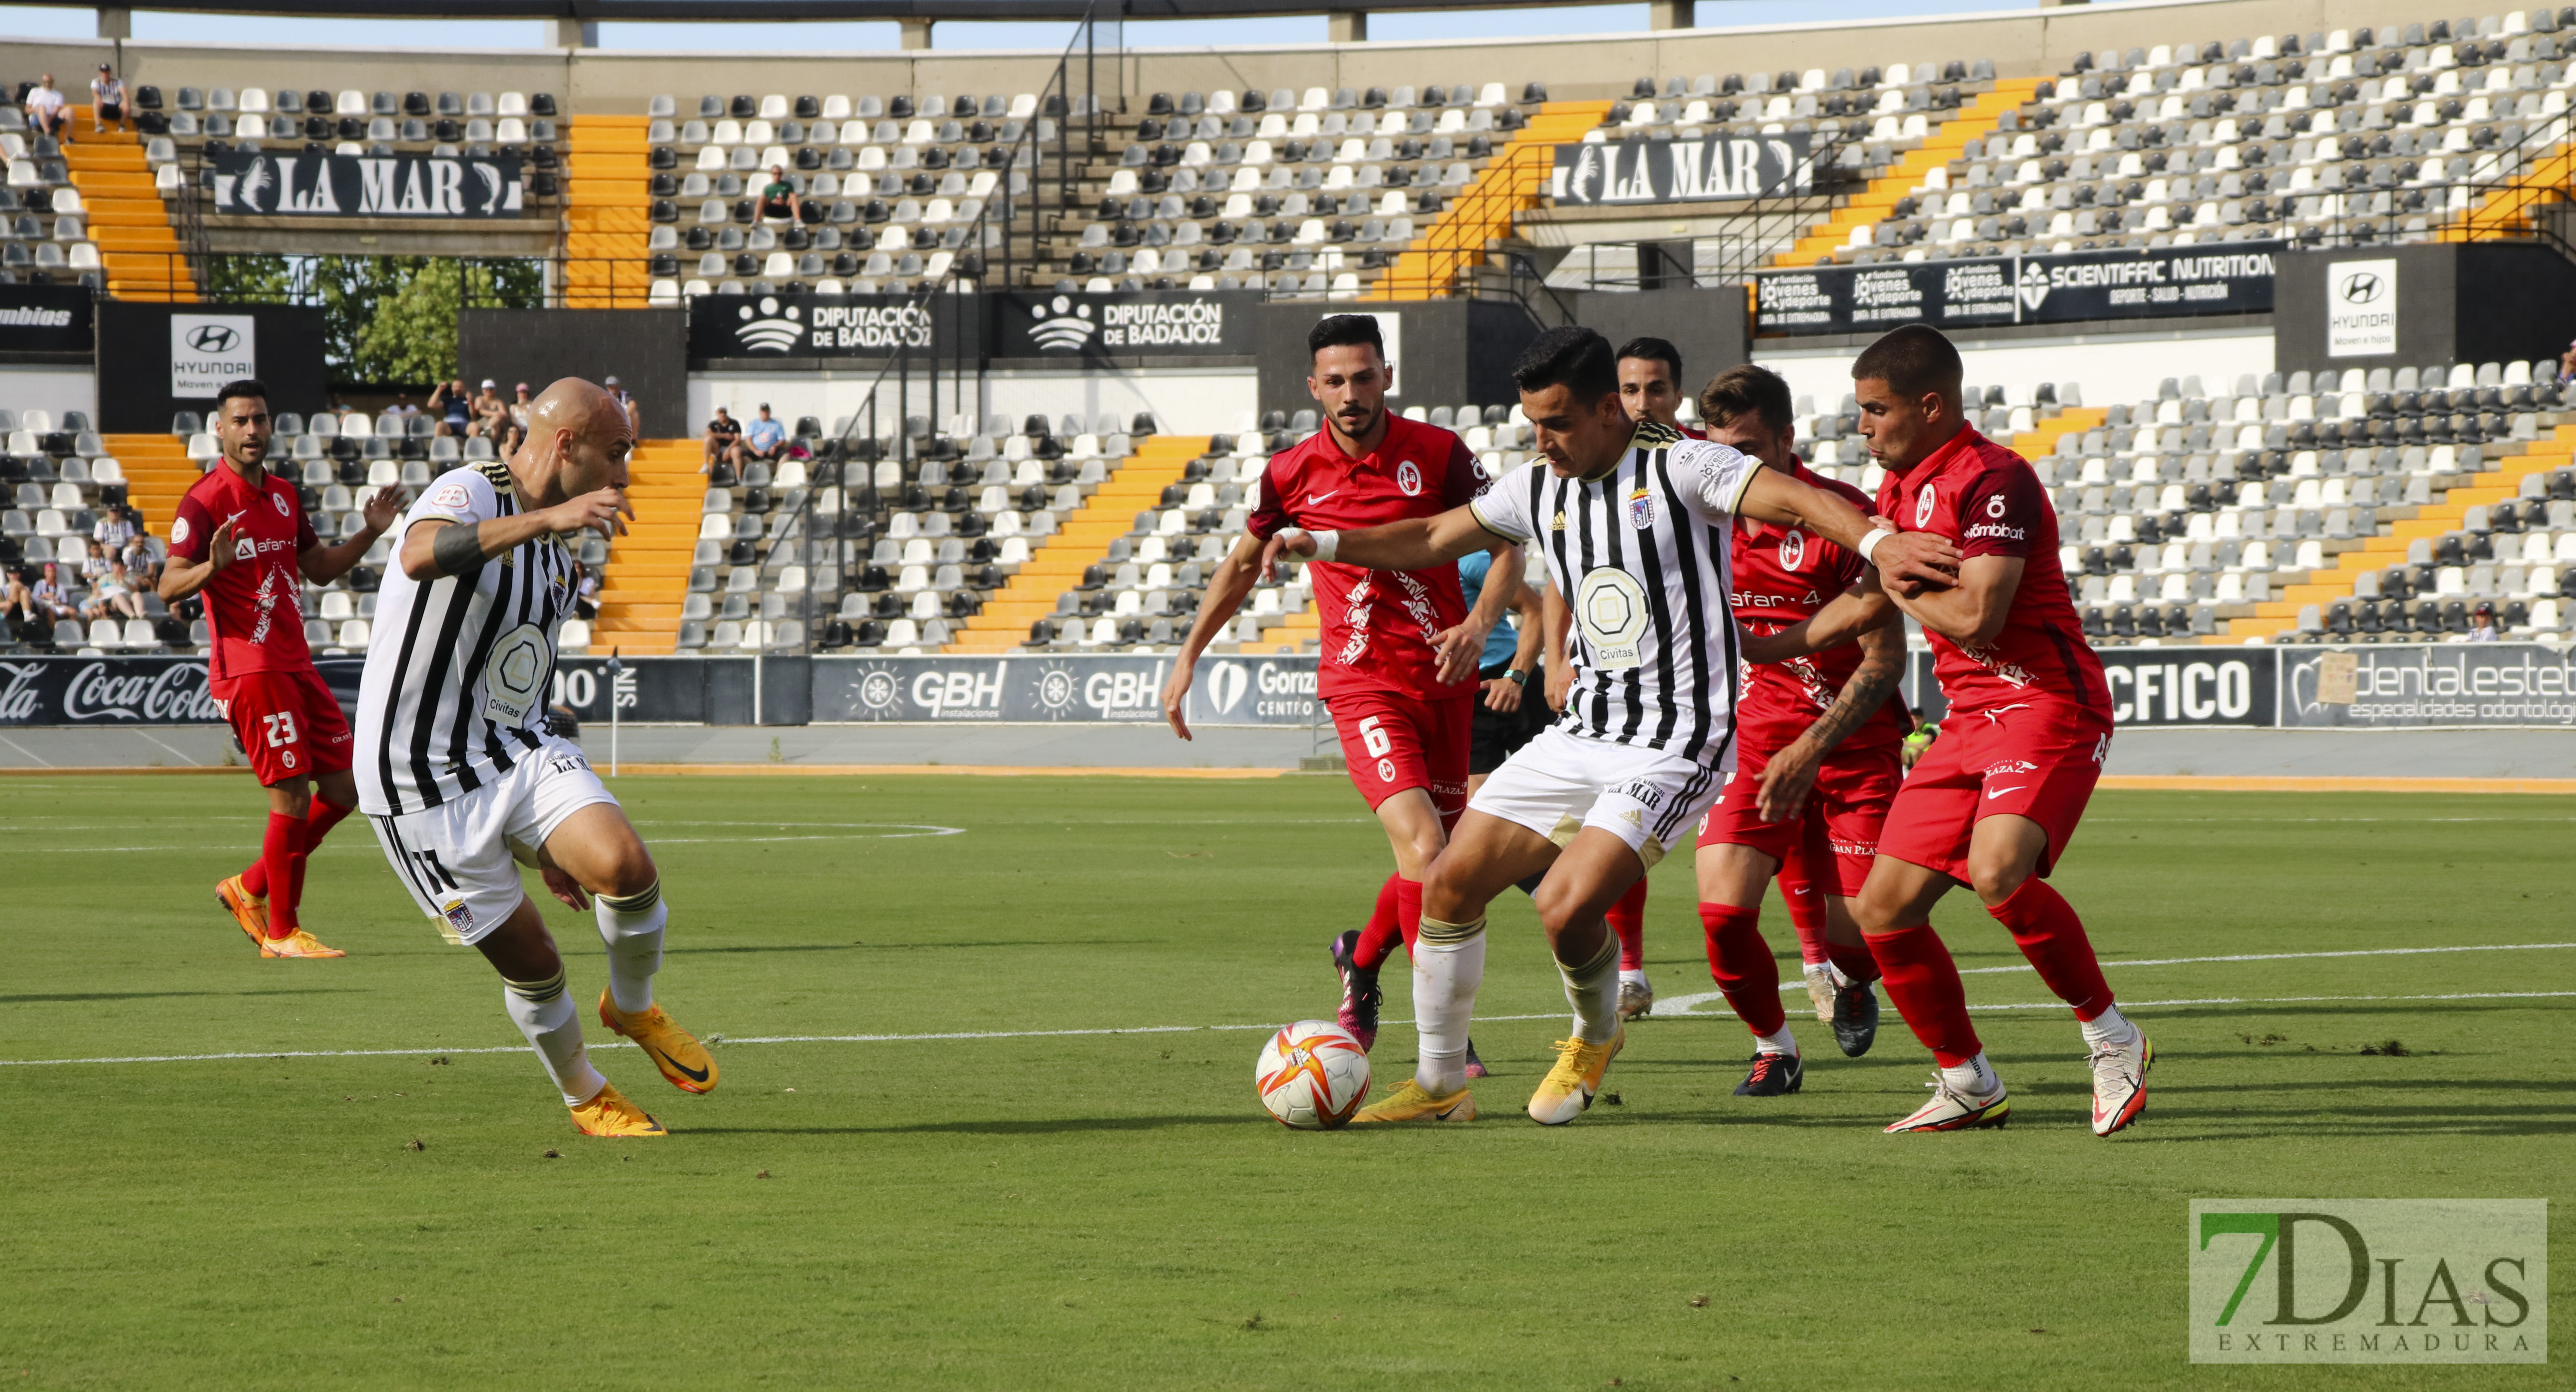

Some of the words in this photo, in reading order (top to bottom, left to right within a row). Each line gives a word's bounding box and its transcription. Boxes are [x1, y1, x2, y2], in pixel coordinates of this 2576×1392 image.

[1600, 144, 1656, 201] LA
[1669, 140, 1761, 197] MAR
[275, 157, 340, 212] LA
[357, 159, 466, 214] MAR
[2051, 261, 2166, 288] SCIENTIFFIC
[2172, 253, 2275, 280] NUTRITION
[812, 300, 932, 327] DIPUTACIÓN
[1104, 297, 1221, 325] DIPUTACIÓN
[2333, 313, 2394, 329] HYUNDAI
[812, 331, 833, 346] DE
[1104, 329, 1124, 344] DE
[1128, 324, 1221, 344] BADAJOZ
[174, 361, 252, 374] HYUNDAI
[1964, 522, 2025, 540] wömbbat
[1600, 648, 1634, 660] Civitas
[911, 661, 1007, 718] GBH
[1084, 660, 1164, 719] GBH
[1258, 661, 1318, 695] Gonz
[490, 699, 520, 718] Civitas
[941, 708, 999, 717] instalaciones
[1110, 709, 1157, 718] instalaciones
[2348, 698, 2476, 722] especialidades
[263, 711, 298, 748] 23
[1359, 715, 1391, 758] 6
[1433, 784, 1460, 795] PLAZA
[1625, 782, 1661, 811] MAR
[1643, 778, 1665, 797] MARISCOS
[1830, 842, 1852, 855] GRAN
[1853, 845, 1877, 855] PLA
[411, 849, 460, 895] 11
